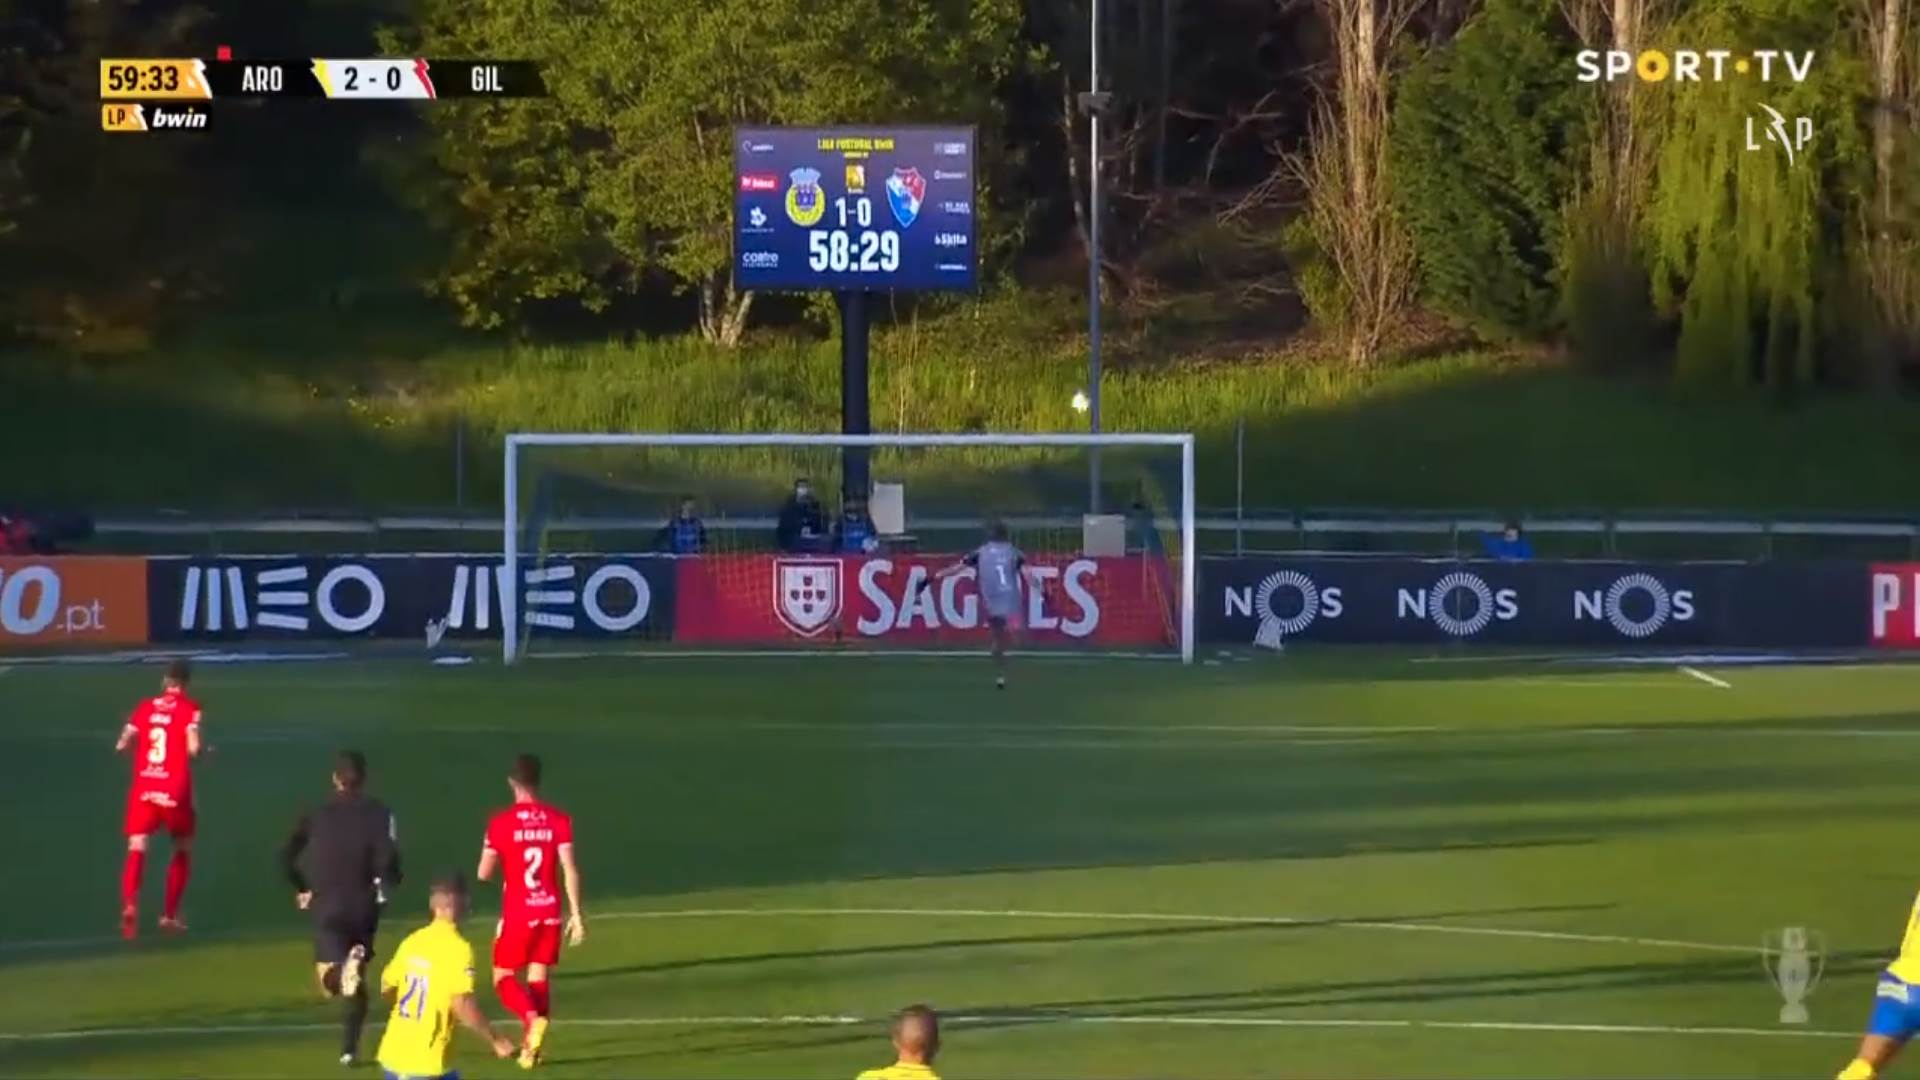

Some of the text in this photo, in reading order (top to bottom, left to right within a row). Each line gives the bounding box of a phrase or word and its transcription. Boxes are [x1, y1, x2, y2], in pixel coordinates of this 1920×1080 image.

[834, 196, 872, 228] 1-0
[808, 230, 900, 272] 58:29
[180, 563, 385, 632] MEO
[857, 558, 1099, 637] SAGES
[1224, 570, 1343, 633] NOS
[1398, 572, 1518, 636] NOS
[1574, 573, 1695, 637] NOS
[148, 727, 167, 764] 3
[523, 846, 543, 890] 2
